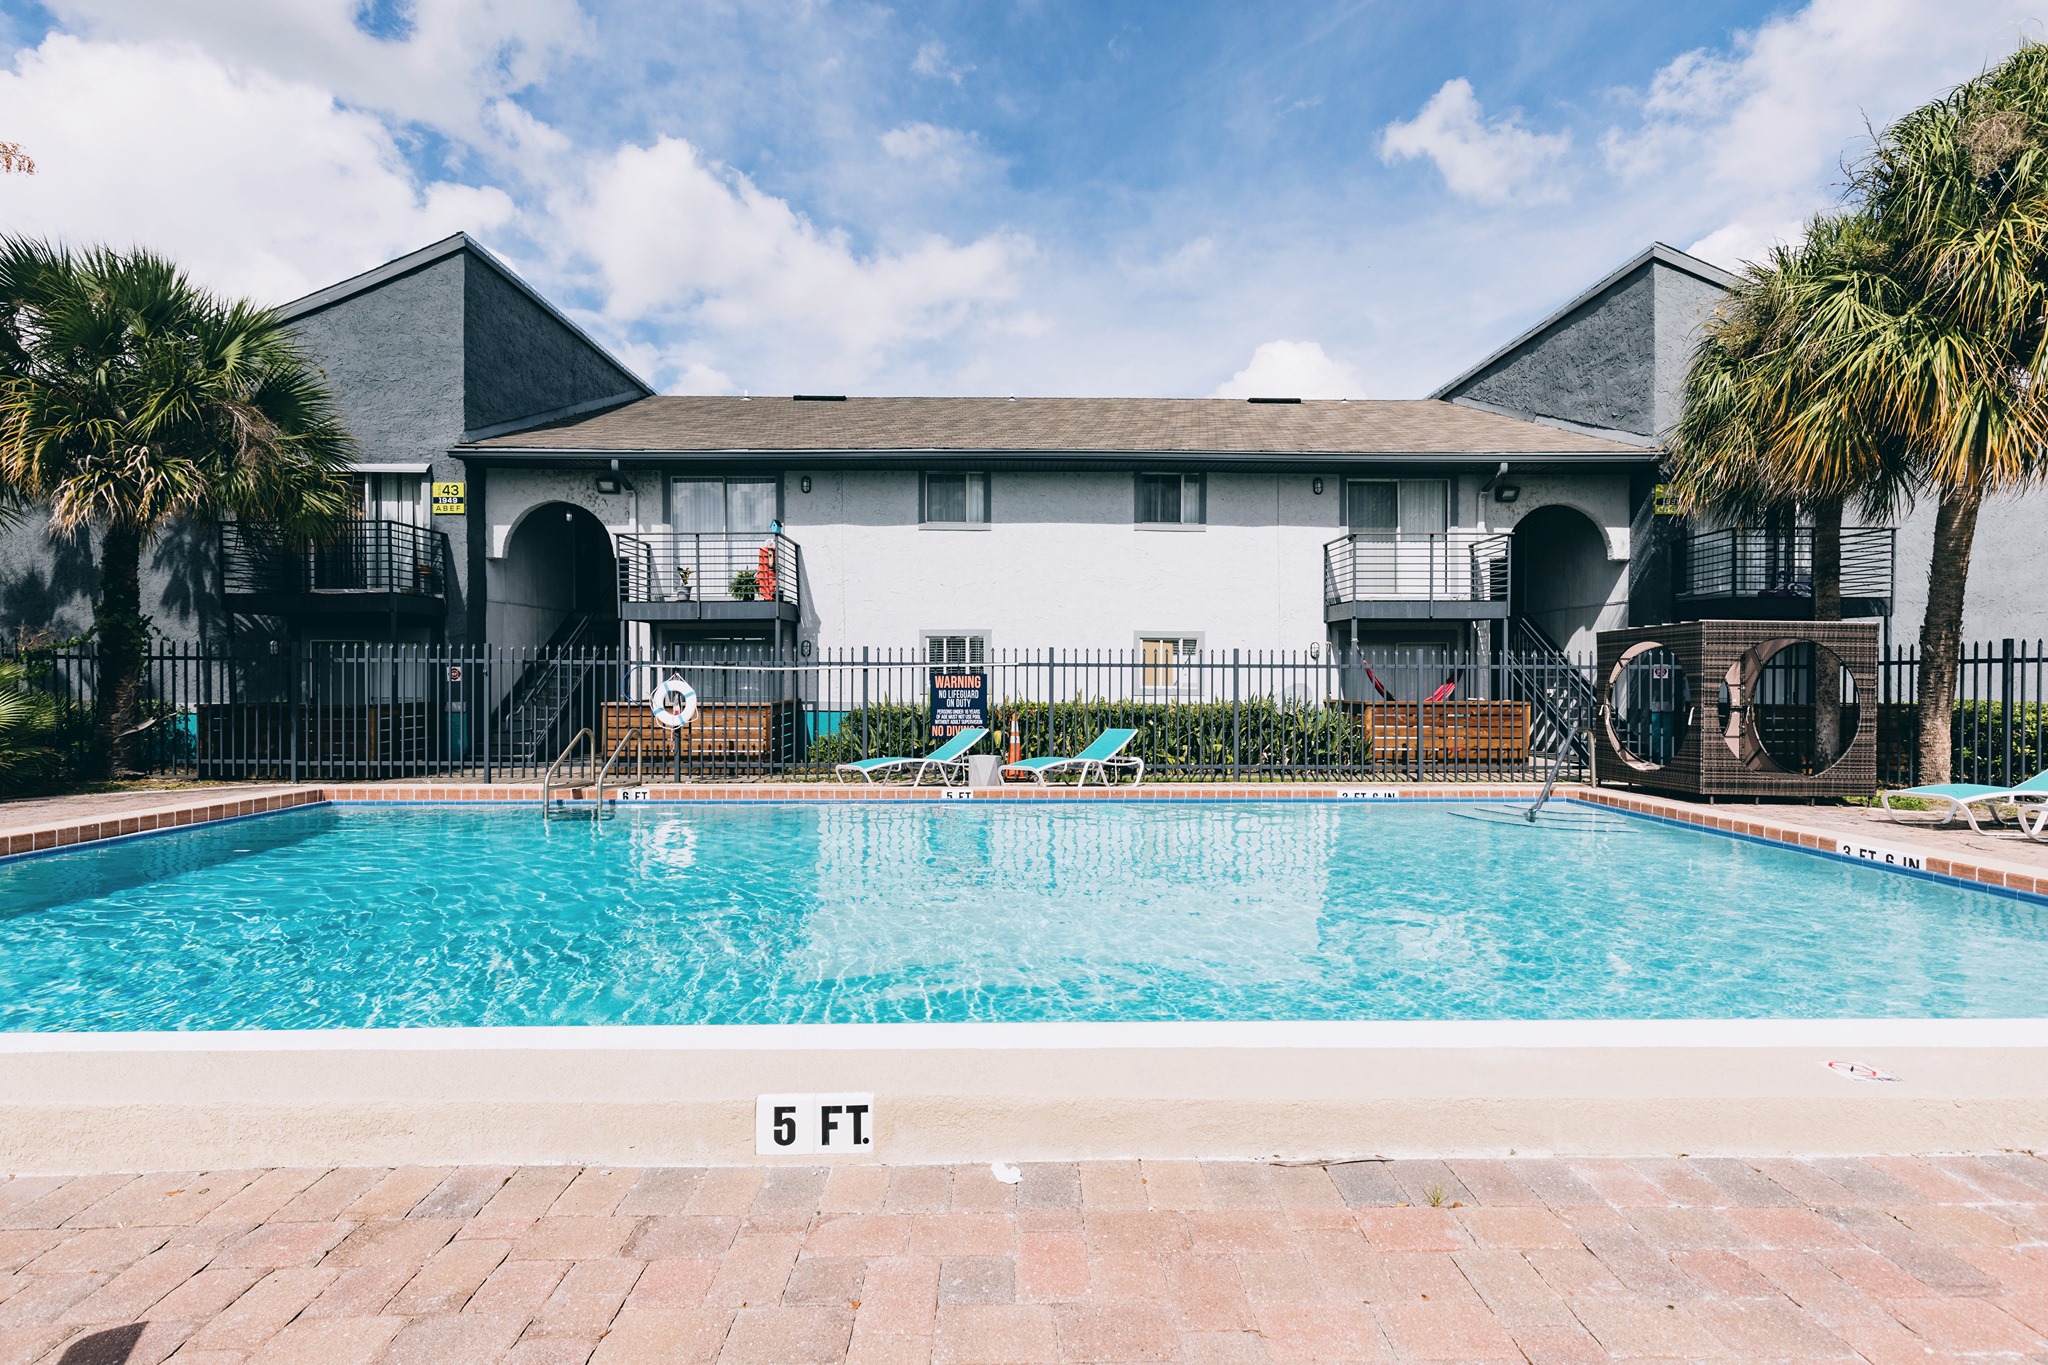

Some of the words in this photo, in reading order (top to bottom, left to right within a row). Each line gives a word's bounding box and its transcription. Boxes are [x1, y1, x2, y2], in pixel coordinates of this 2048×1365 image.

[442, 485, 459, 496] 43
[934, 675, 981, 689] WARNING
[938, 689, 947, 699] NO
[947, 689, 979, 699] LIFEGUARD
[946, 699, 955, 708] ON
[955, 699, 971, 708] DUTY
[931, 725, 944, 737] NO
[946, 725, 975, 737] DIV
[634, 791, 648, 800] FT
[958, 791, 972, 799] FT
[773, 1106, 796, 1146] 5
[821, 1104, 870, 1146] FT.
